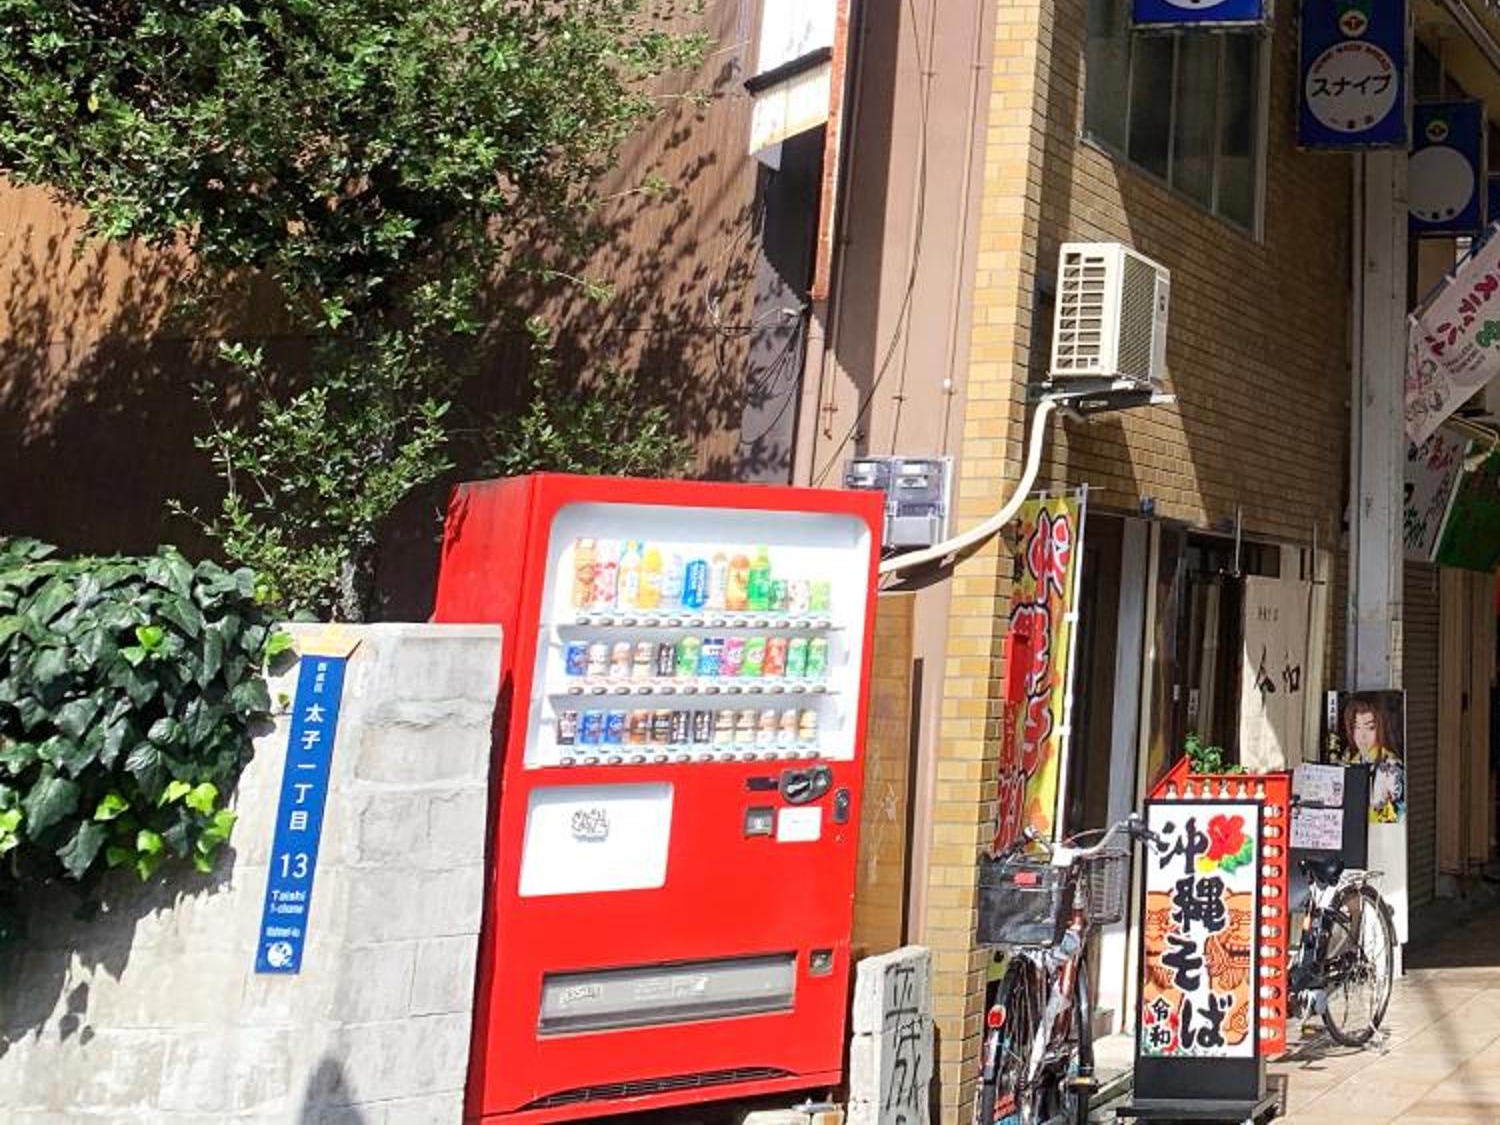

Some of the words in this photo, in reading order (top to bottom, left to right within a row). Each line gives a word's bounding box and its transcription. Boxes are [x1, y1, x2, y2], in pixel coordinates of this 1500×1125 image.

[289, 703, 326, 832] 太子一丁目
[279, 853, 308, 878] 13
[1157, 817, 1233, 1049] 沖縄そば
[1149, 997, 1172, 1048] 令和
